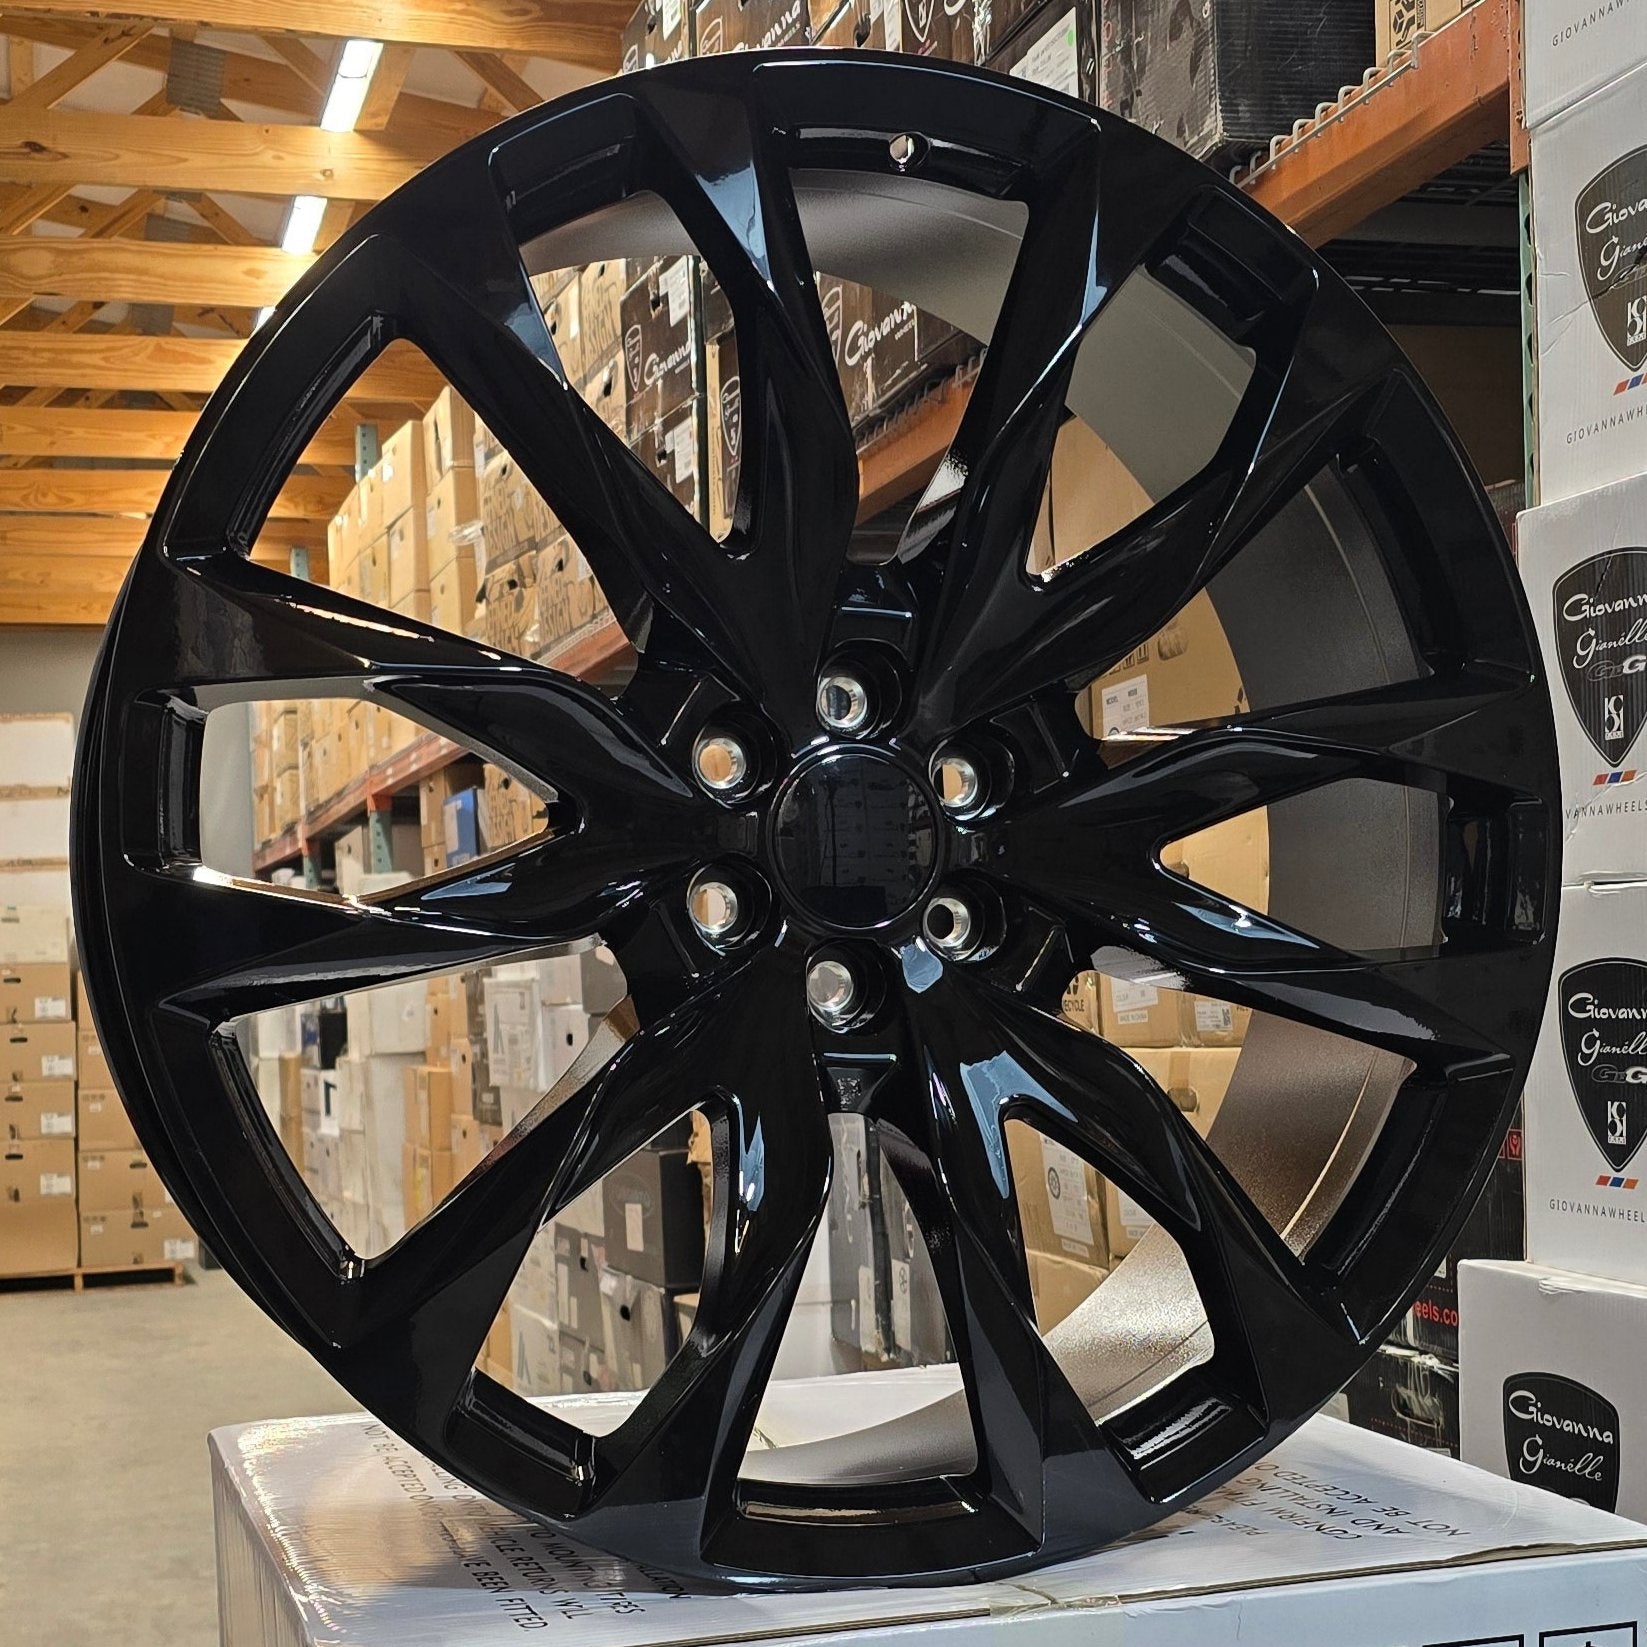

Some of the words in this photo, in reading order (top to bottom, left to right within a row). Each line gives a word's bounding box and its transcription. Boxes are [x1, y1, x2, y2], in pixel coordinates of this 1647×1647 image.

[1566, 404, 1647, 444] GIOVANNAWH
[1508, 1389, 1614, 1445] Giovanna
[1273, 1470, 1378, 1505] ACCEPTED
[1370, 1506, 1411, 1517] BE
[1350, 1518, 1411, 1535] AND
[1405, 1519, 1471, 1537] NOT
[471, 1571, 515, 1594] BEEN
